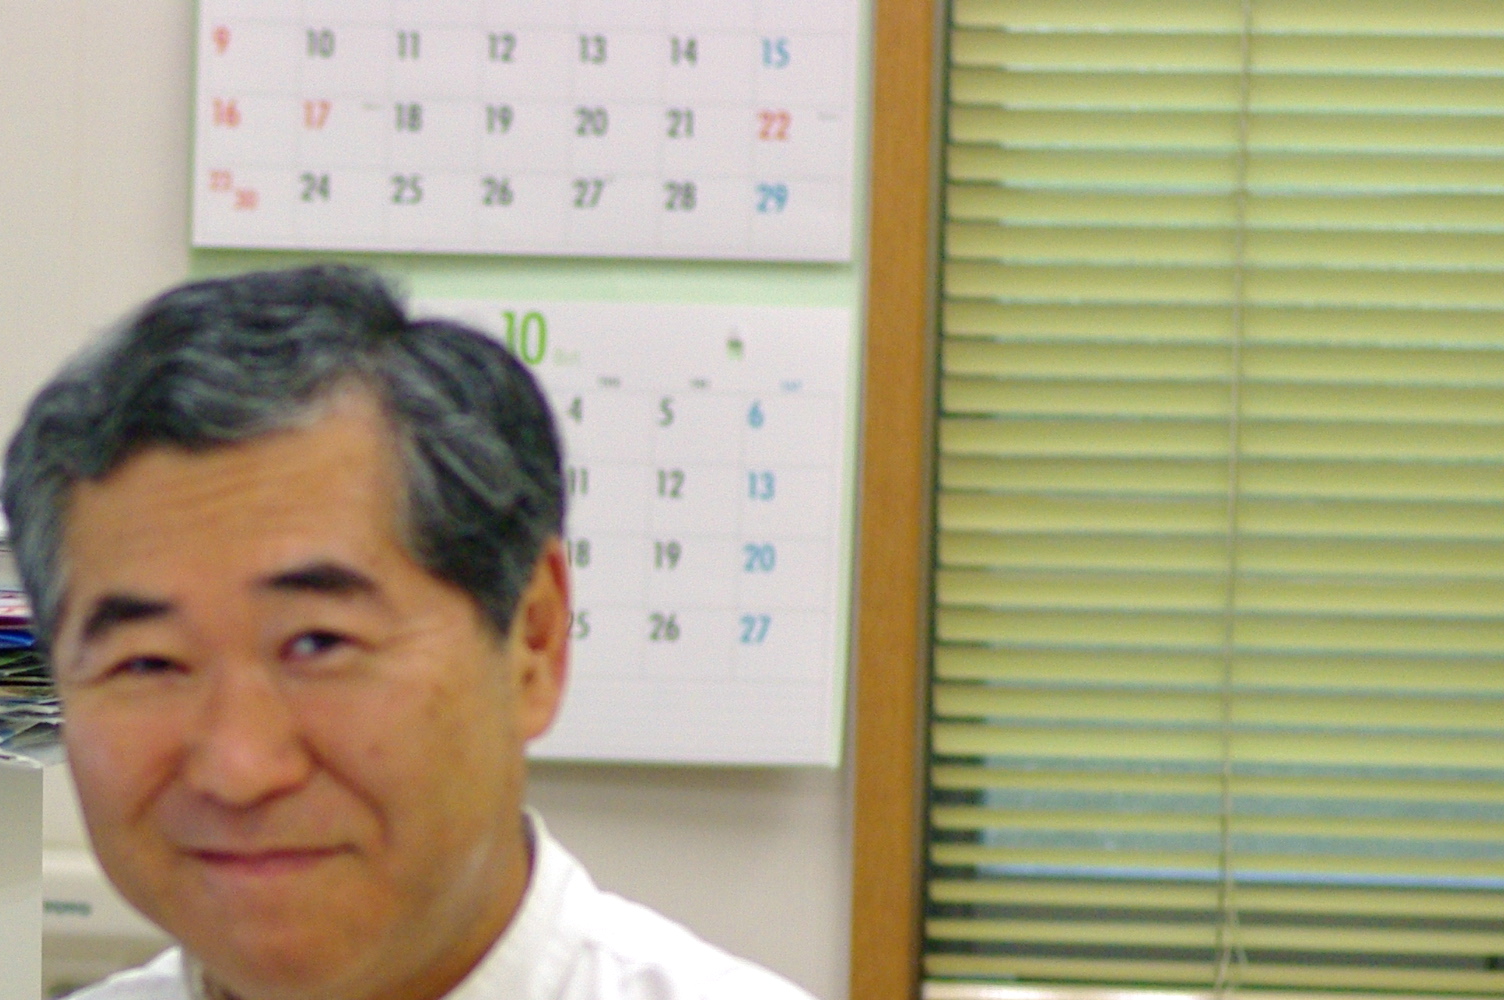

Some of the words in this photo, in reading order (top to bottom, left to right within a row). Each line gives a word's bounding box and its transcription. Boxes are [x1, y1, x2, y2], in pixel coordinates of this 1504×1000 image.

[212, 26, 230, 54] 9
[306, 28, 336, 59] 10
[396, 30, 420, 60] 11
[488, 32, 517, 63] 12
[579, 34, 607, 65] 13
[670, 37, 698, 65] 14
[762, 38, 791, 69] 15
[213, 99, 241, 128] 16
[303, 100, 331, 129] 17
[395, 103, 422, 132] 18
[486, 105, 514, 133] 19
[575, 106, 609, 137] 20
[666, 108, 694, 139] 21
[758, 110, 791, 141] 22
[300, 172, 330, 202] 24
[391, 174, 423, 205] 25
[482, 176, 514, 206] 26
[572, 178, 605, 209] 27
[664, 181, 696, 211] 28
[756, 183, 789, 213] 29
[501, 311, 547, 366] 10
[567, 397, 584, 423] 4
[659, 397, 675, 427] 5
[747, 402, 765, 429] 6
[566, 467, 589, 495] 11
[656, 469, 685, 499] 12
[748, 471, 775, 501] 13
[654, 540, 682, 569] 19
[743, 543, 776, 573] 20
[648, 612, 681, 642] 26
[739, 614, 772, 645] 27
